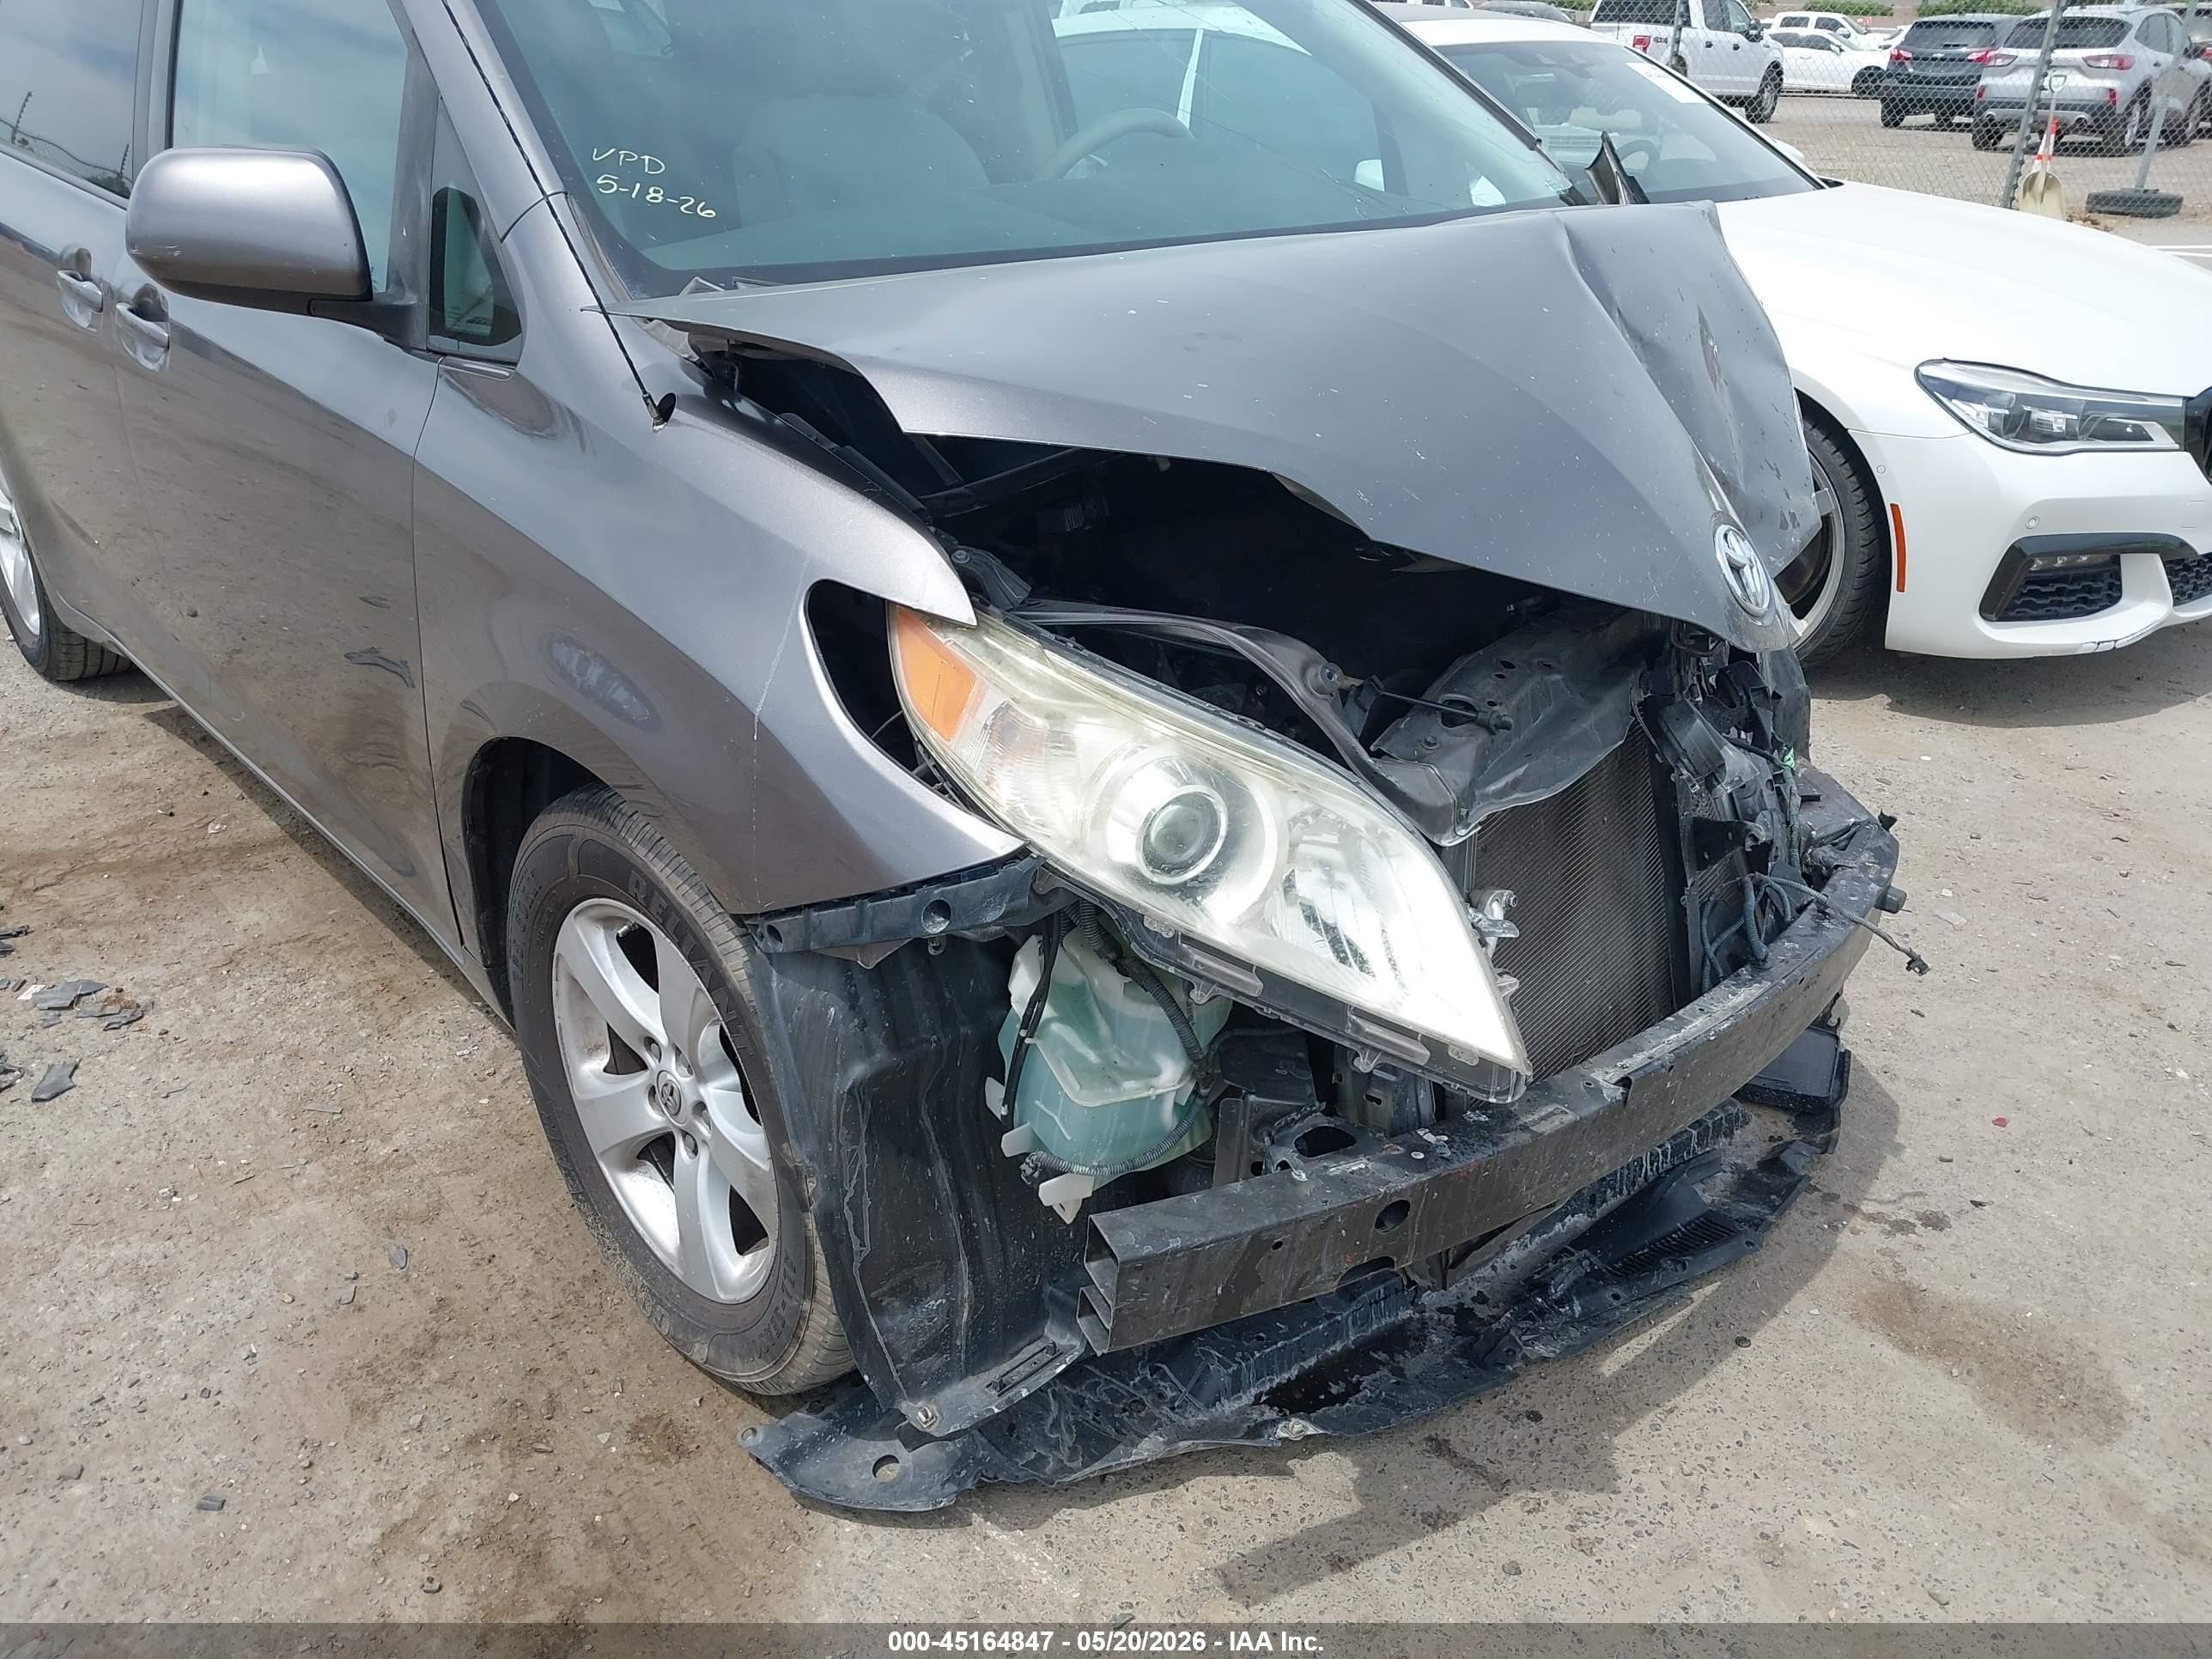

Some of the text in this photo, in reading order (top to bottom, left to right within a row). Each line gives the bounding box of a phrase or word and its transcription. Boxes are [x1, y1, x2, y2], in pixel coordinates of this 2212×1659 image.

[592, 147, 665, 174] VPD
[596, 173, 716, 218] 5-18-26
[628, 869, 754, 1056] RELIANT
